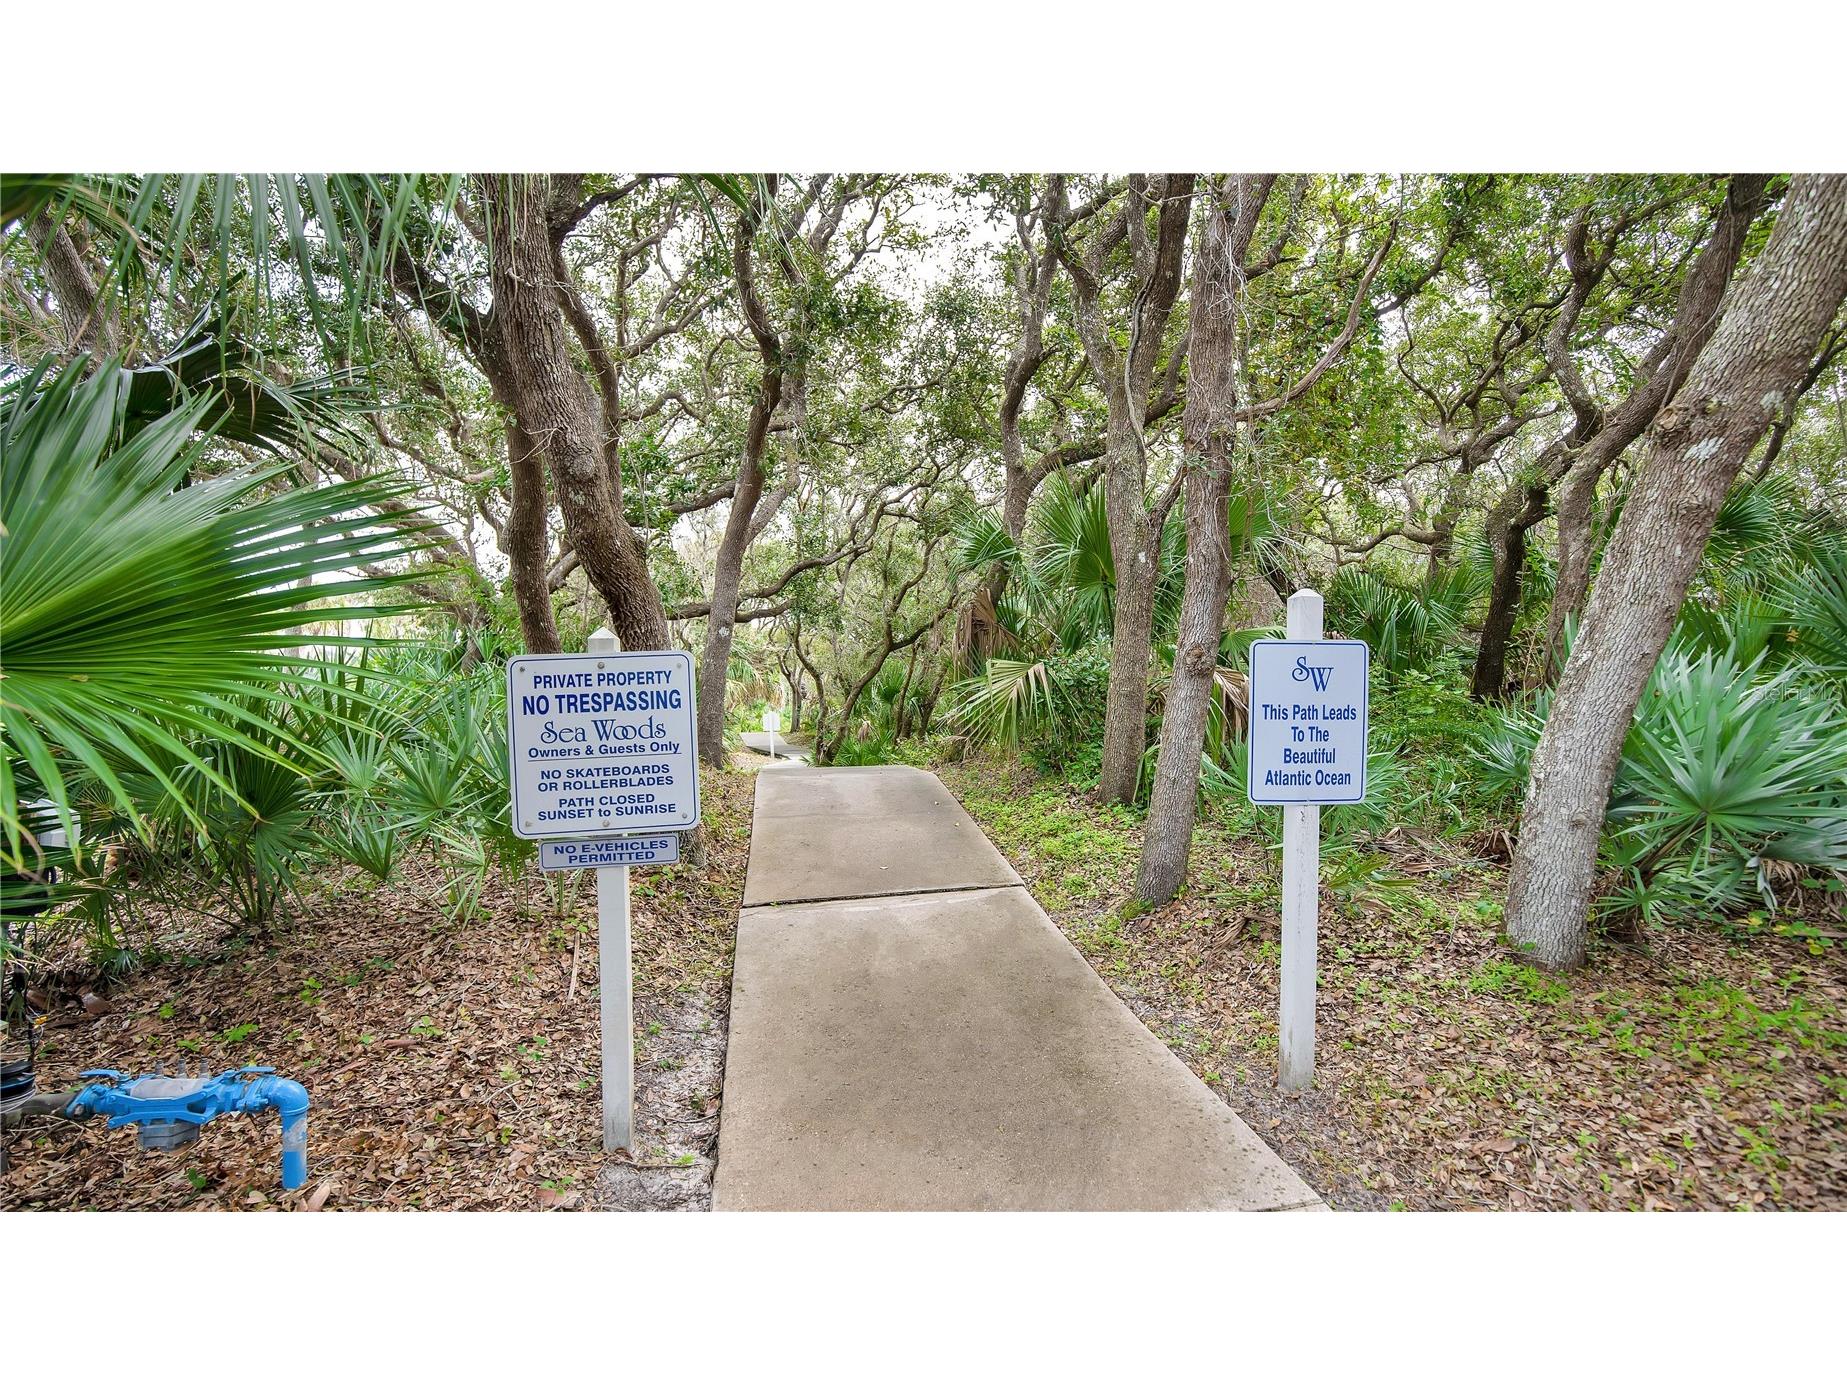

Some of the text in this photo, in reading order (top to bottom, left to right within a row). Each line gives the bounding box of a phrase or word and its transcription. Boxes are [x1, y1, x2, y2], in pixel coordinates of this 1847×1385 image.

[533, 670, 672, 689] PRIVATE PROPERTY
[1292, 656, 1334, 692] SW
[522, 690, 681, 715] NO TRESPASSING
[1262, 704, 1356, 720] This Path Leads
[540, 715, 666, 744] Sea Woods
[1291, 727, 1329, 742] To The
[529, 741, 680, 759] Owners & Guests Only
[1284, 748, 1335, 763] Beautiful
[541, 764, 670, 780] NO SKATEBOARDS
[1265, 770, 1351, 785] Atlantic Ocean
[538, 776, 673, 792] OR ROLLERBLADES
[559, 794, 655, 808] PATH CLOSED
[538, 803, 676, 820] SUNSET to SUNRISE
[554, 840, 668, 855] NO E-VEHICLES
[568, 851, 655, 863] PERMITTED
